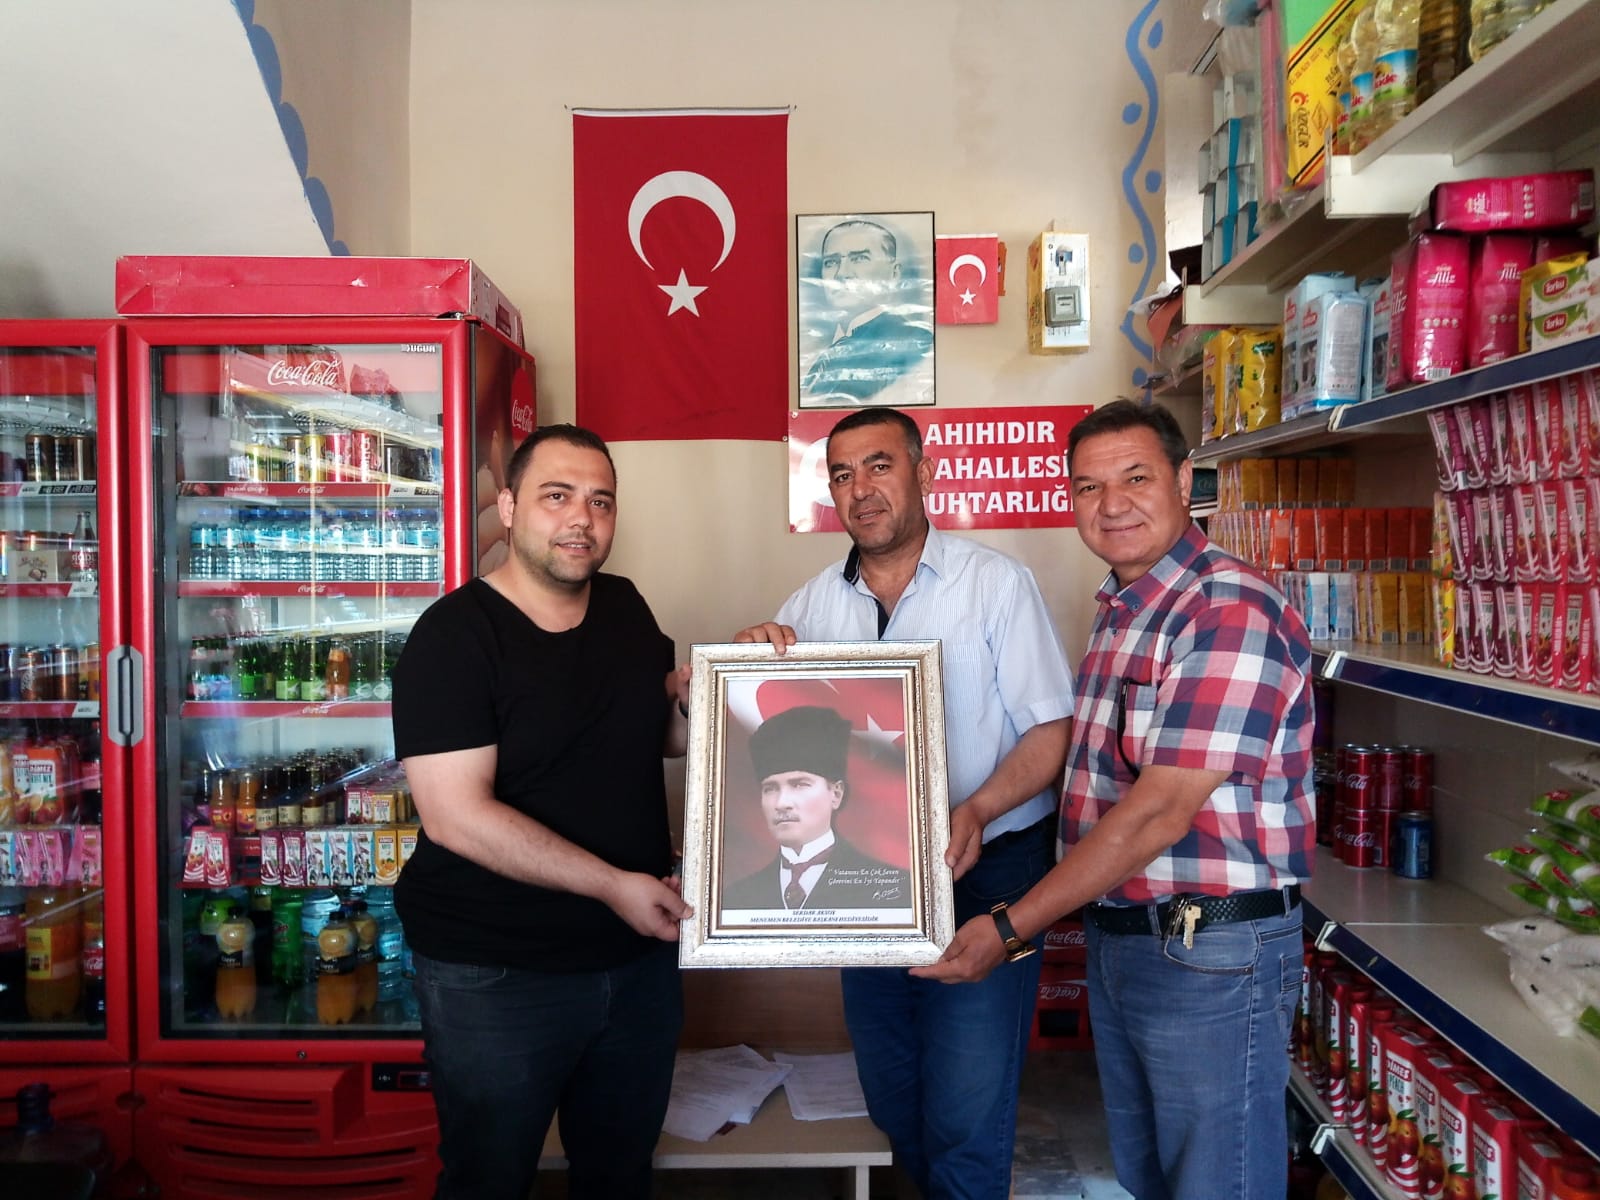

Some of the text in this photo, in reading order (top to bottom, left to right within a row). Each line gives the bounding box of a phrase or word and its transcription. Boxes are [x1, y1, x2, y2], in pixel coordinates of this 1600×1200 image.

[1546, 279, 1565, 294] Torku
[1546, 316, 1565, 330] Torku
[268, 359, 341, 387] Coca-Cola
[511, 400, 534, 434] Coca-Cola
[924, 420, 1056, 446] AHIHIDIR
[933, 449, 1070, 481] AHALLESİ
[924, 484, 1074, 515] UHTARLIĞ
